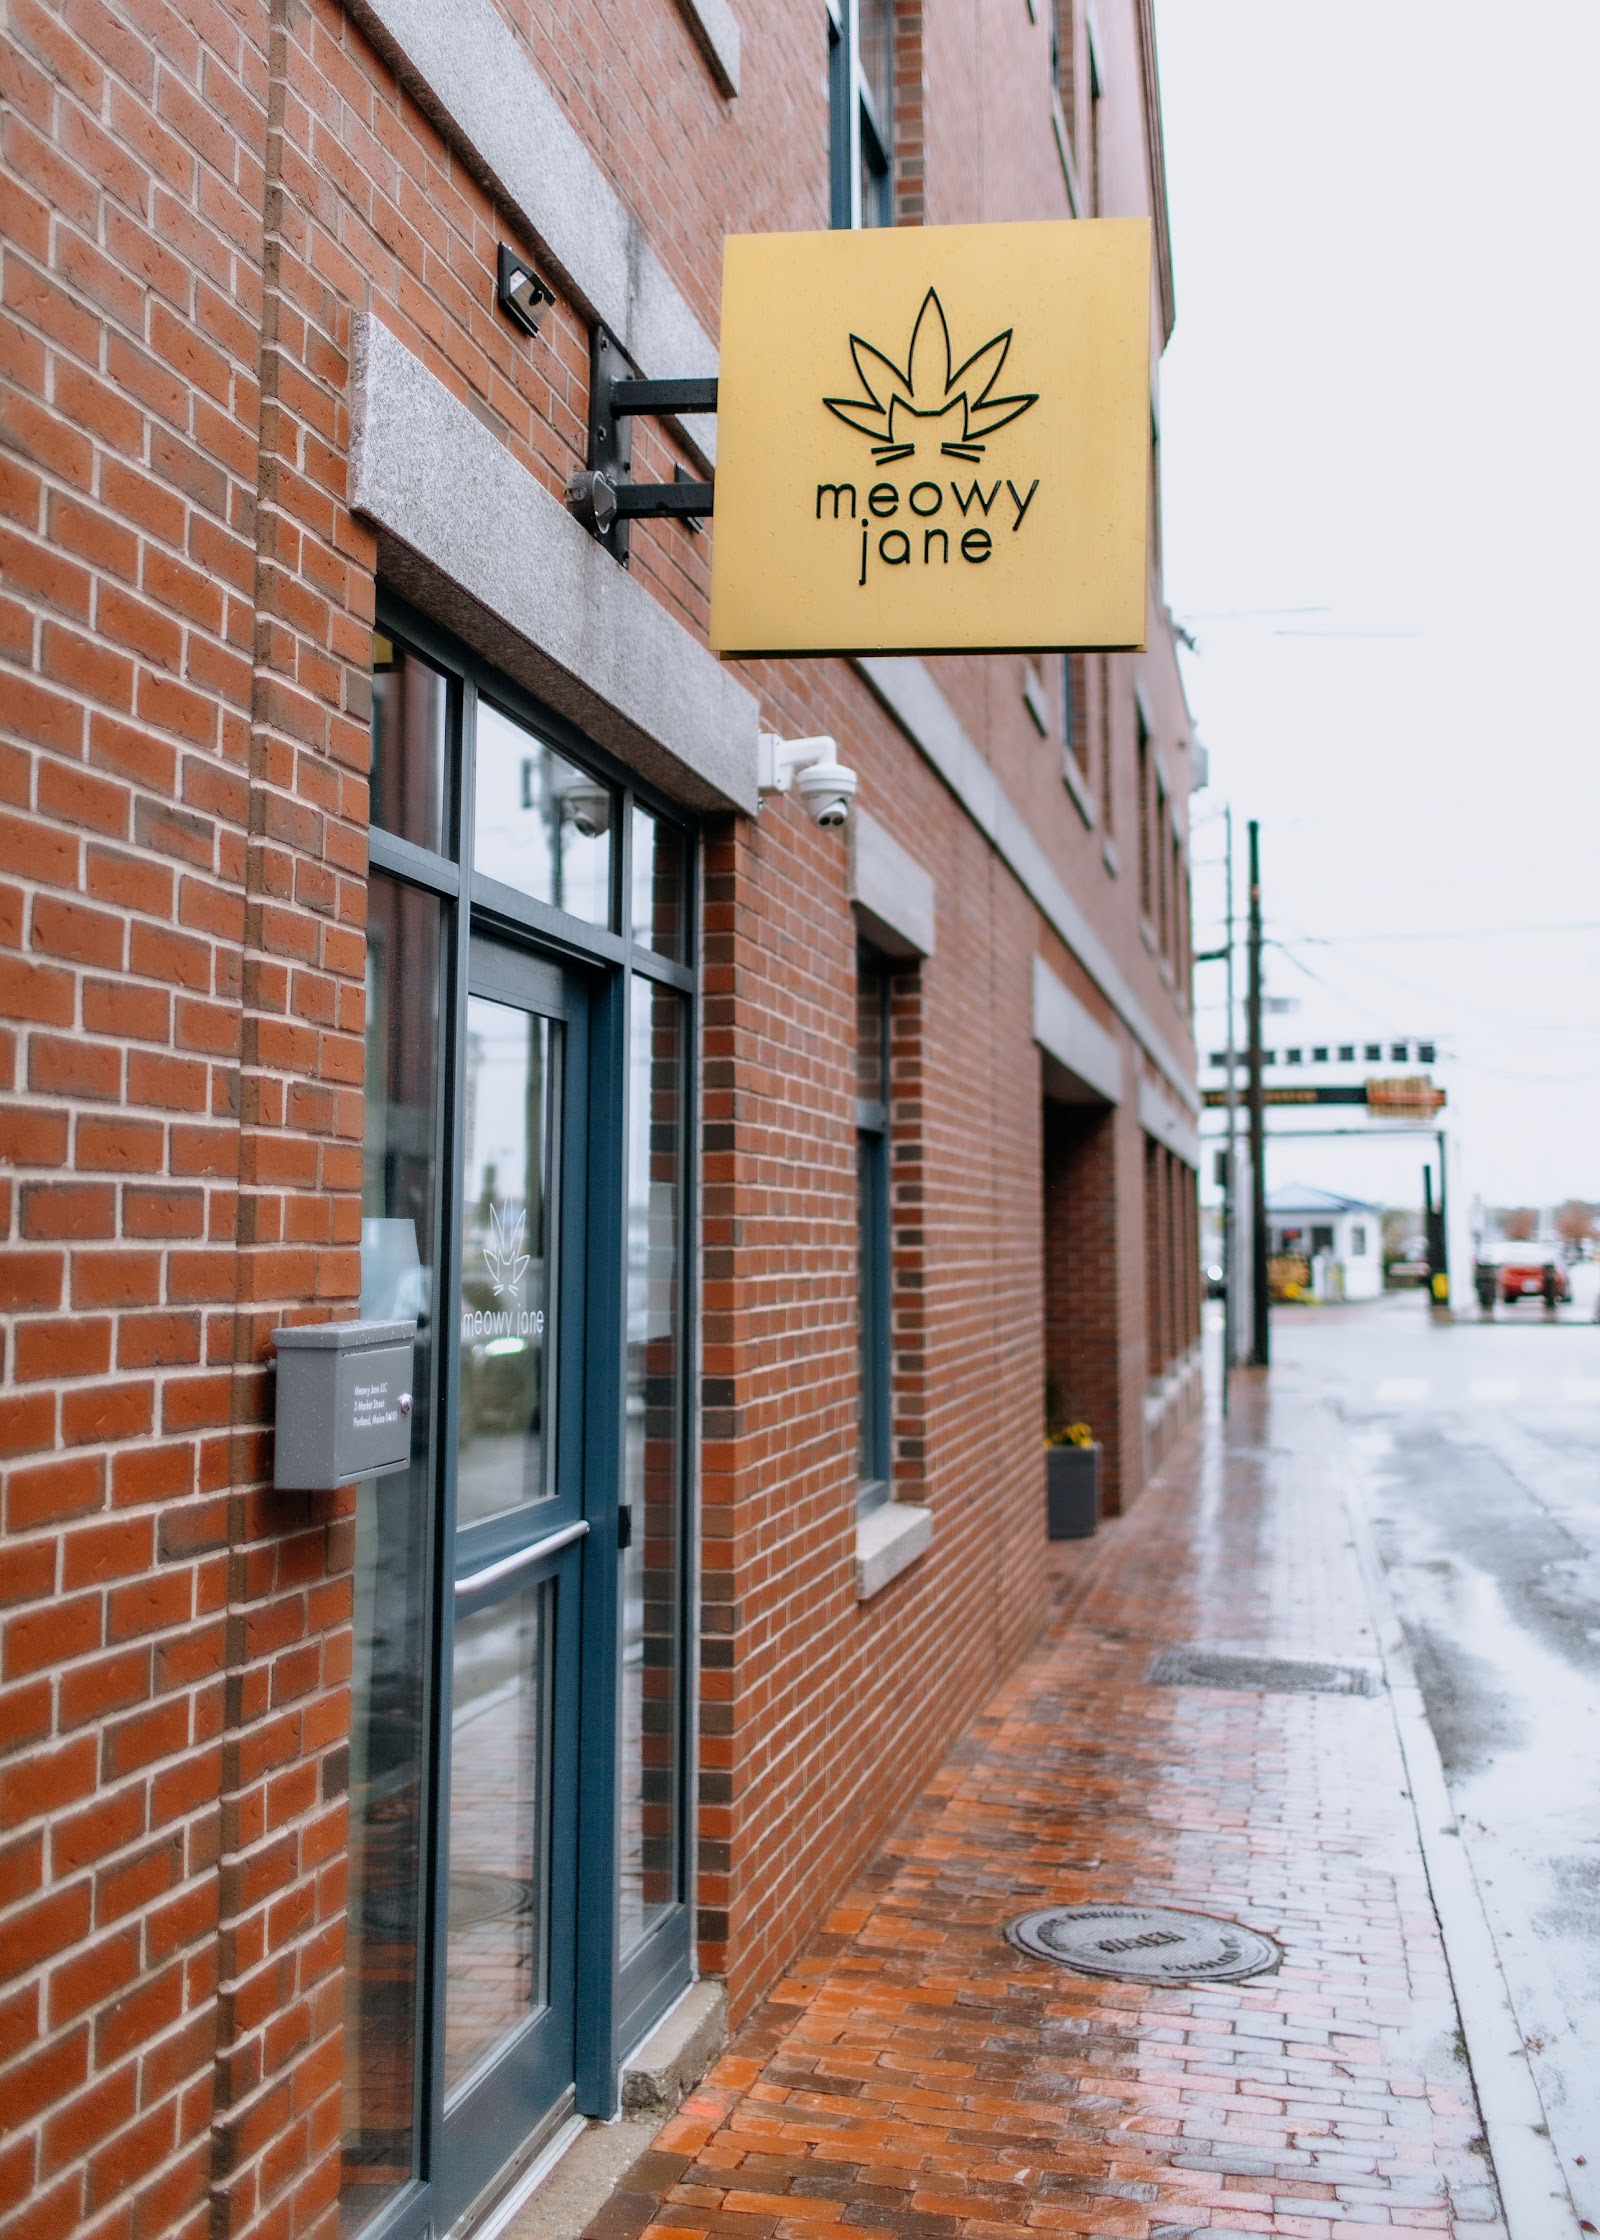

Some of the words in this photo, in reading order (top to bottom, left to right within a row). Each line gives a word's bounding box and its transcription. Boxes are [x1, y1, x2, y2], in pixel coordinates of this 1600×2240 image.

[816, 479, 1040, 531] meowy
[858, 518, 993, 586] jane
[462, 1310, 514, 1338] meowy
[516, 1303, 544, 1338] jane
[354, 1385, 370, 1397] Meowy
[371, 1384, 380, 1394] Jane
[358, 1400, 373, 1411] Market
[373, 1399, 385, 1409] Street
[373, 1413, 385, 1424] Maine
